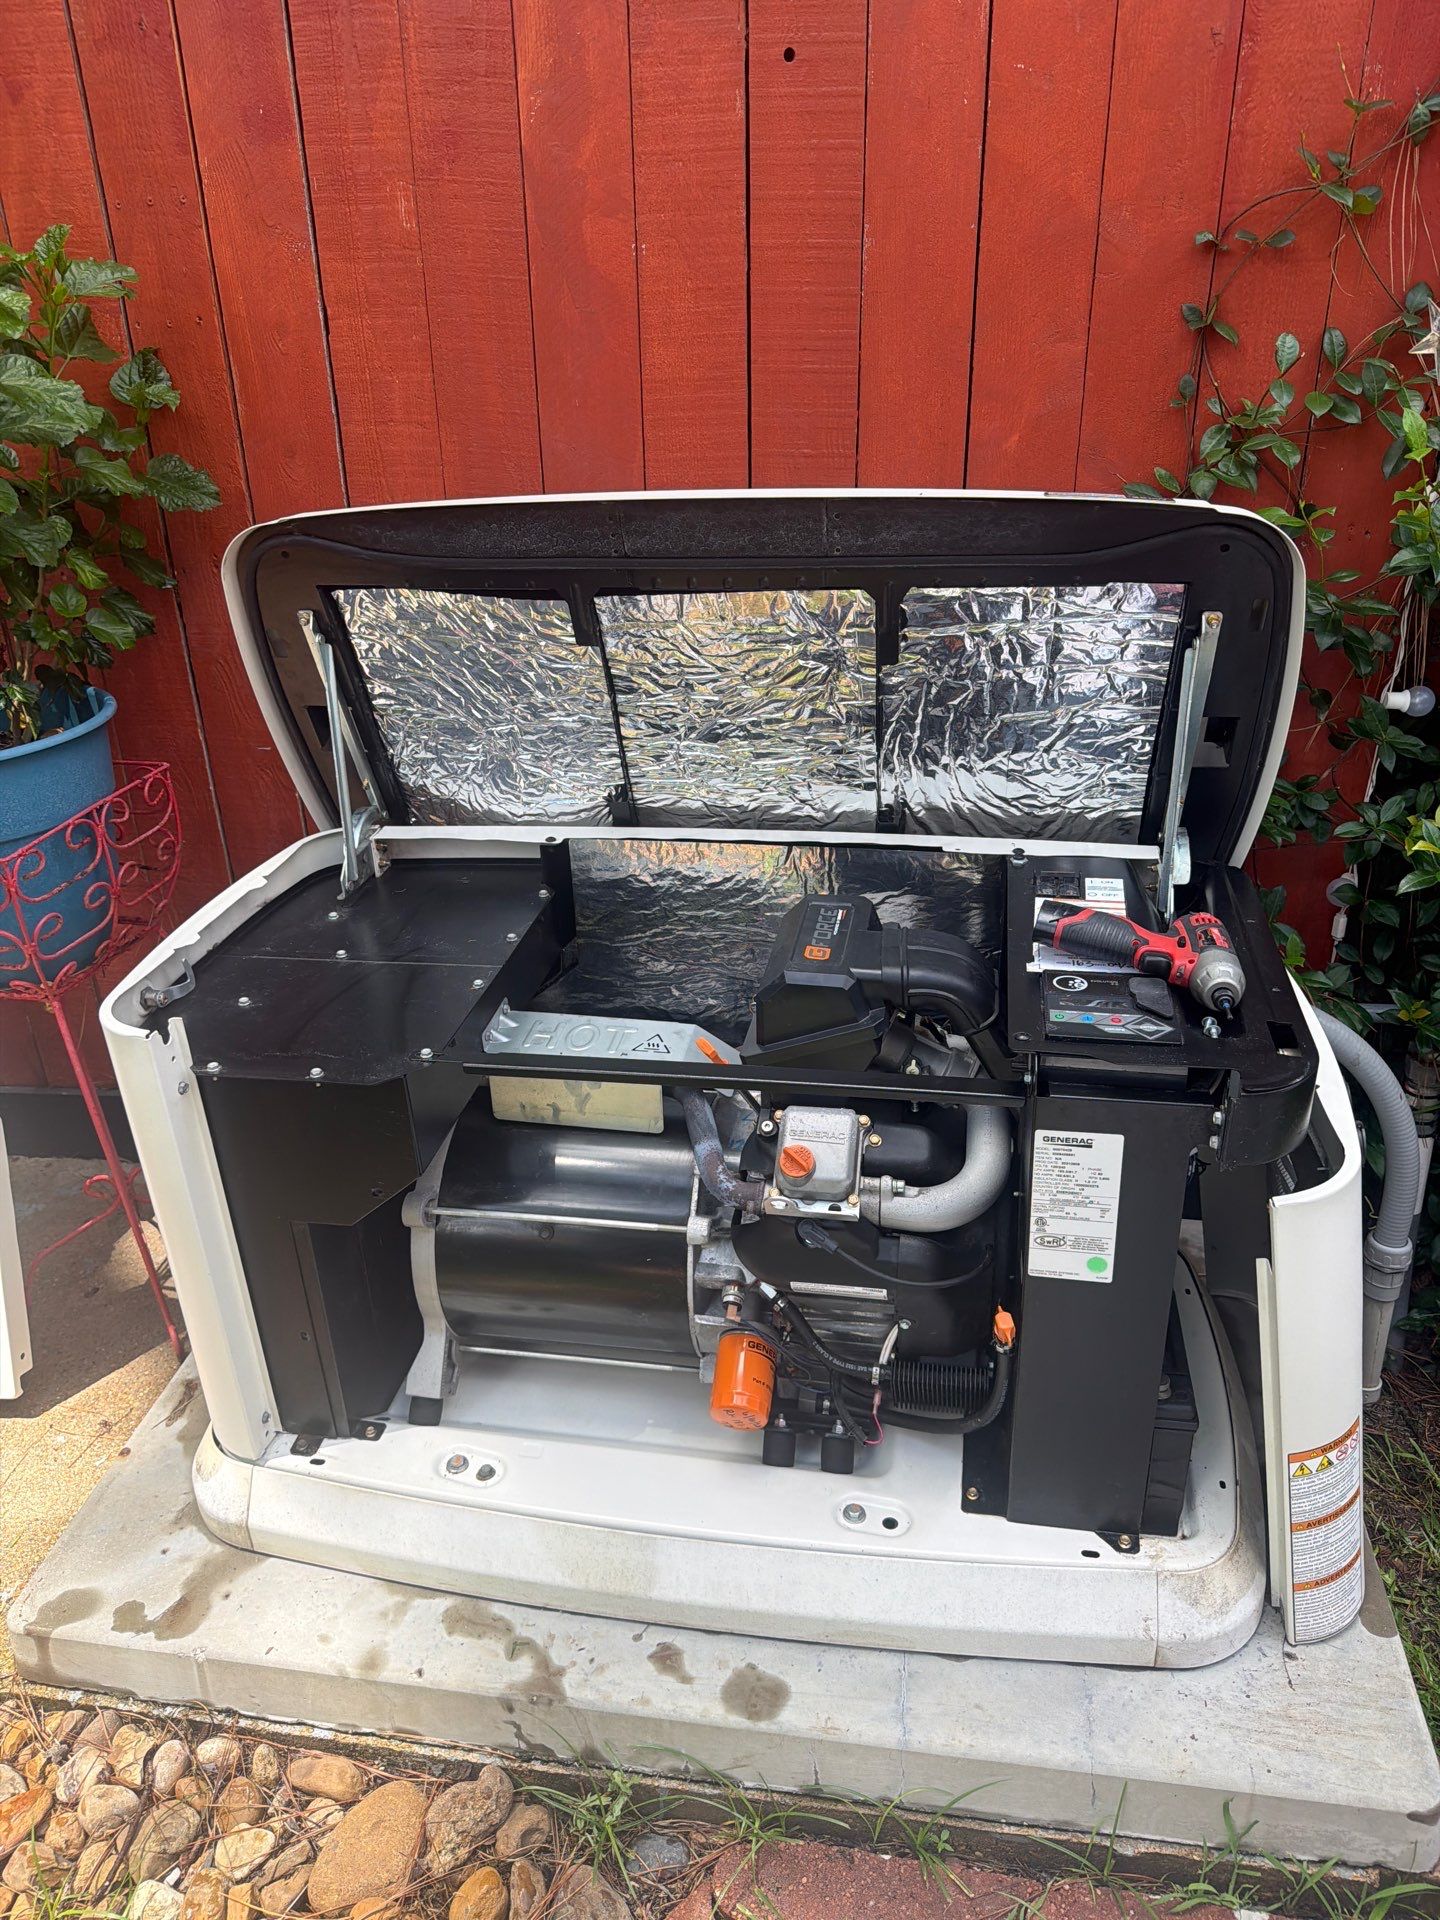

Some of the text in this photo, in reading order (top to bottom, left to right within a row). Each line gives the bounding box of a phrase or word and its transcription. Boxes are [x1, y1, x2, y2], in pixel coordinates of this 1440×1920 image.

[523, 1019, 639, 1054] HOT
[789, 1129, 847, 1140] GENERAC
[1042, 1135, 1094, 1145] GENERAC
[1320, 1429, 1352, 1454] WARNING
